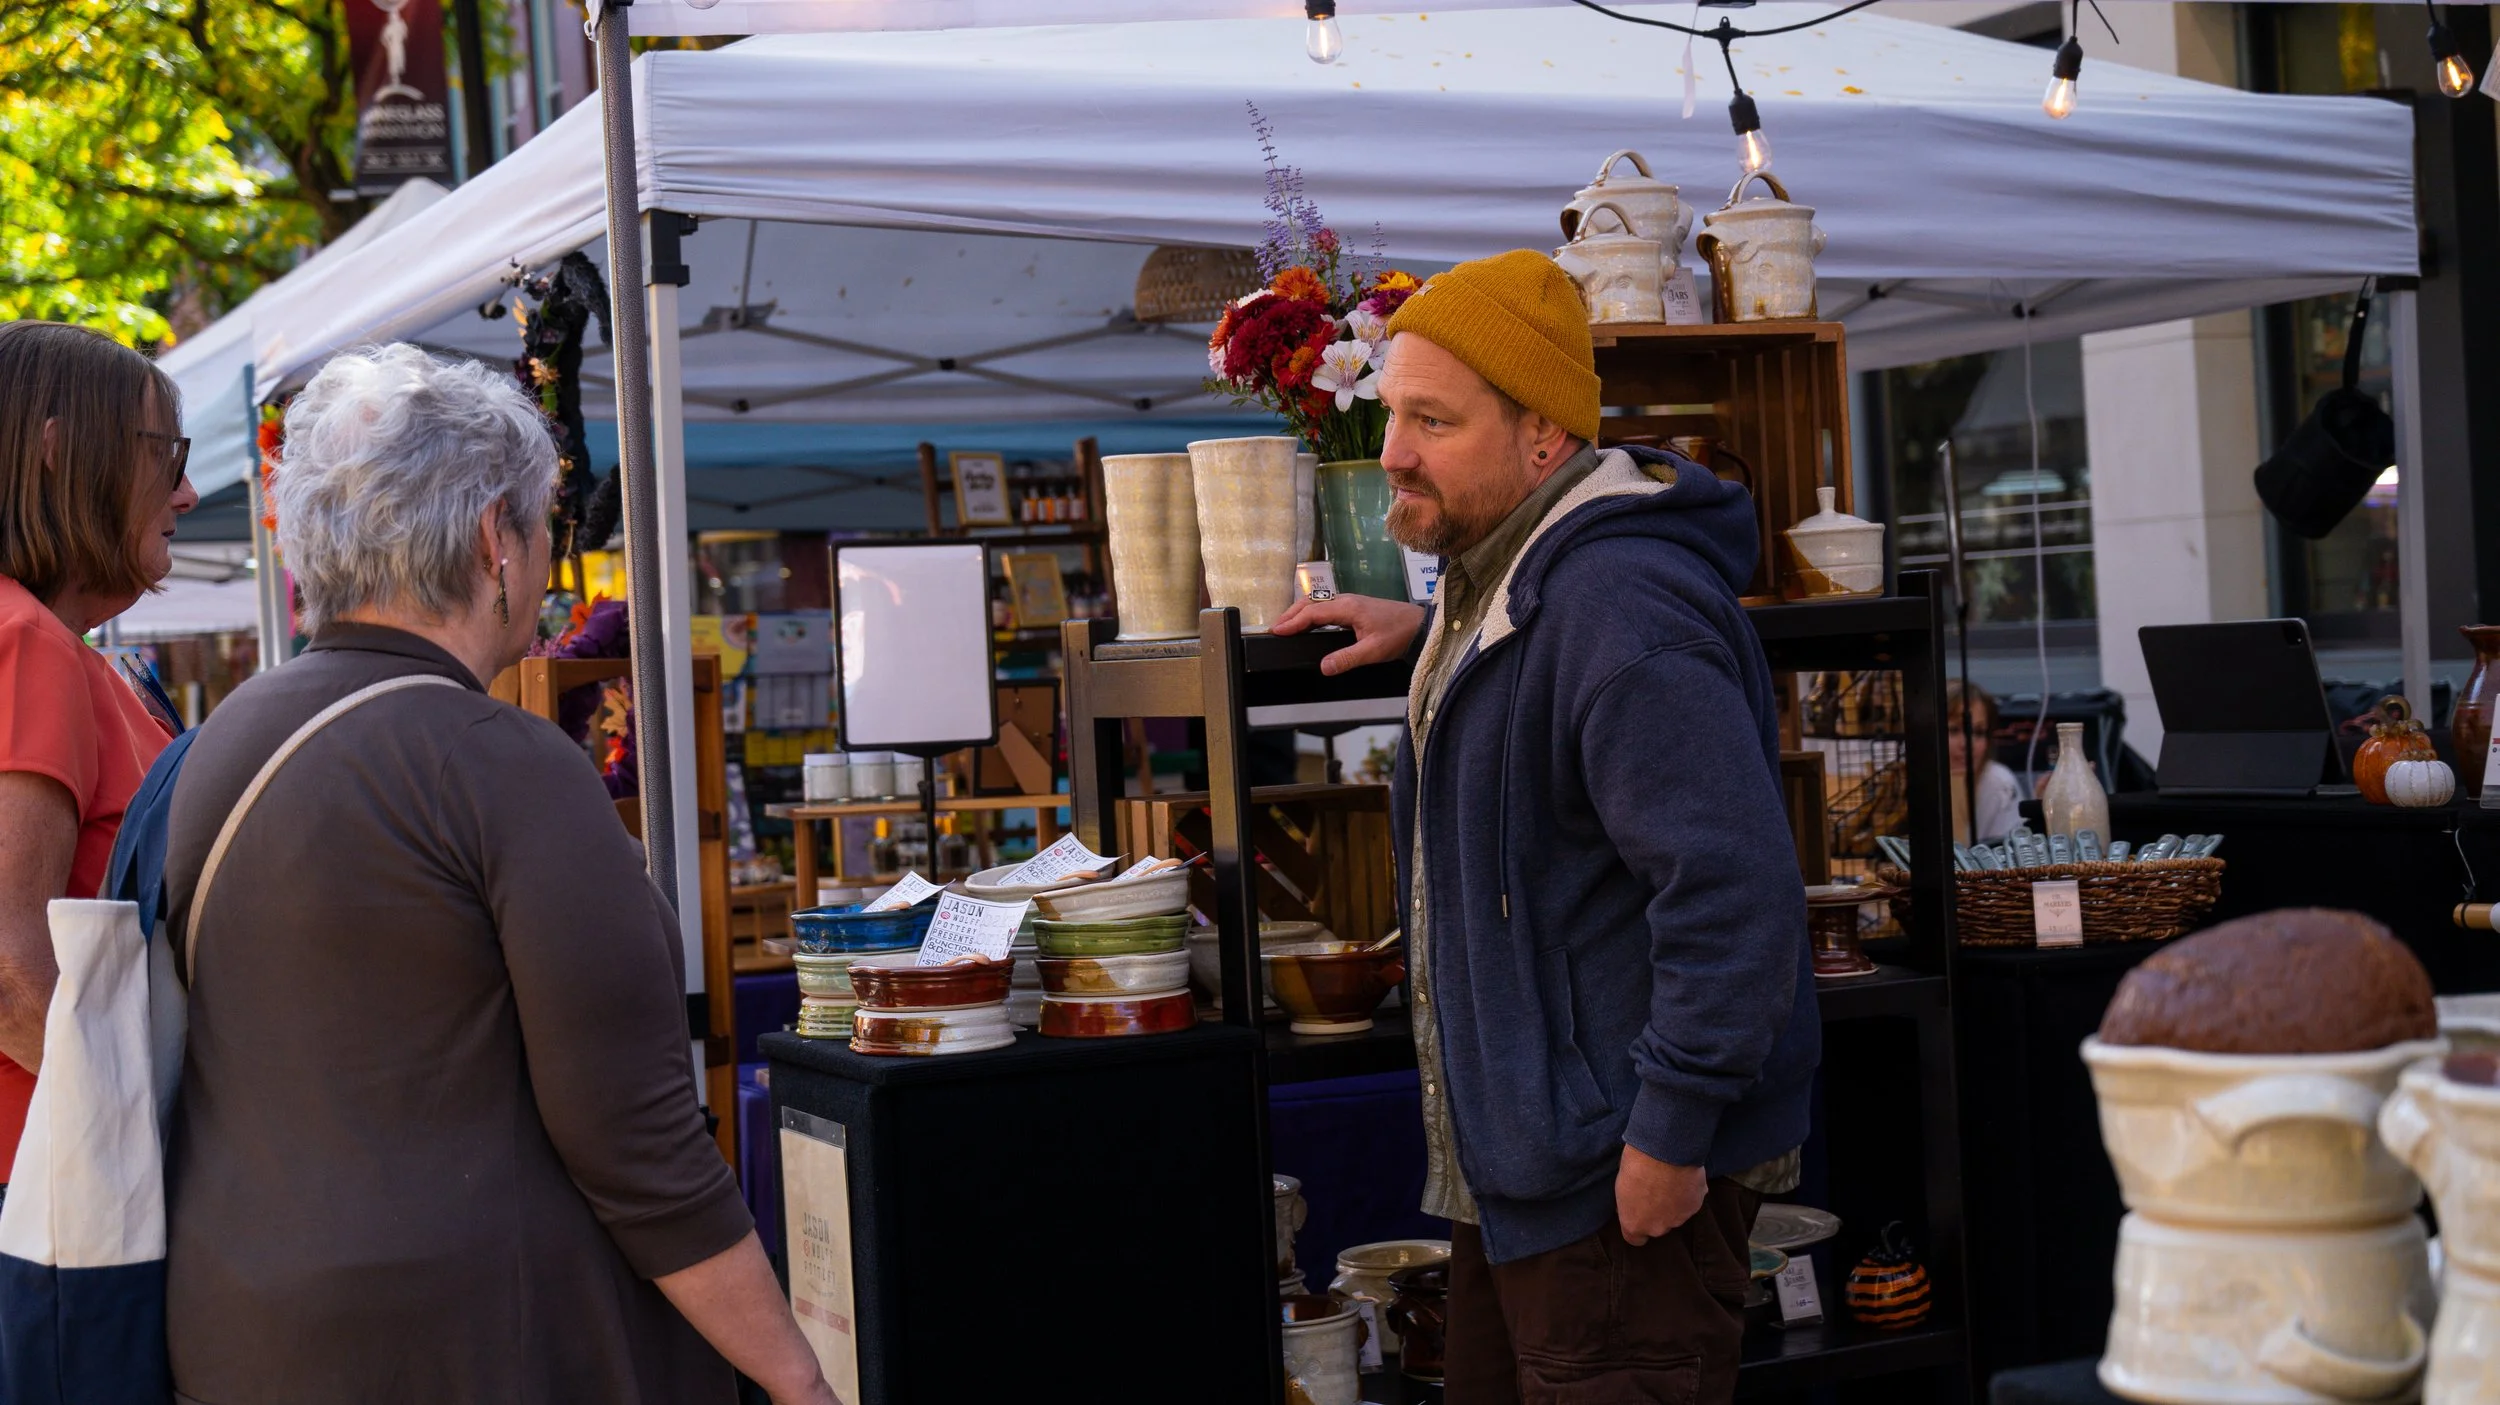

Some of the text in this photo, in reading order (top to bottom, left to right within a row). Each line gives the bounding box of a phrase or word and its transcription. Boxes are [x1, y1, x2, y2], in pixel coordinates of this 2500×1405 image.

[1061, 843, 1090, 865] JASON
[944, 899, 985, 917] JASON
[937, 920, 977, 935] POTTERY
[953, 914, 980, 926] WOLFF
[932, 929, 974, 945] PRESENTS
[803, 1212, 830, 1244] JASON
